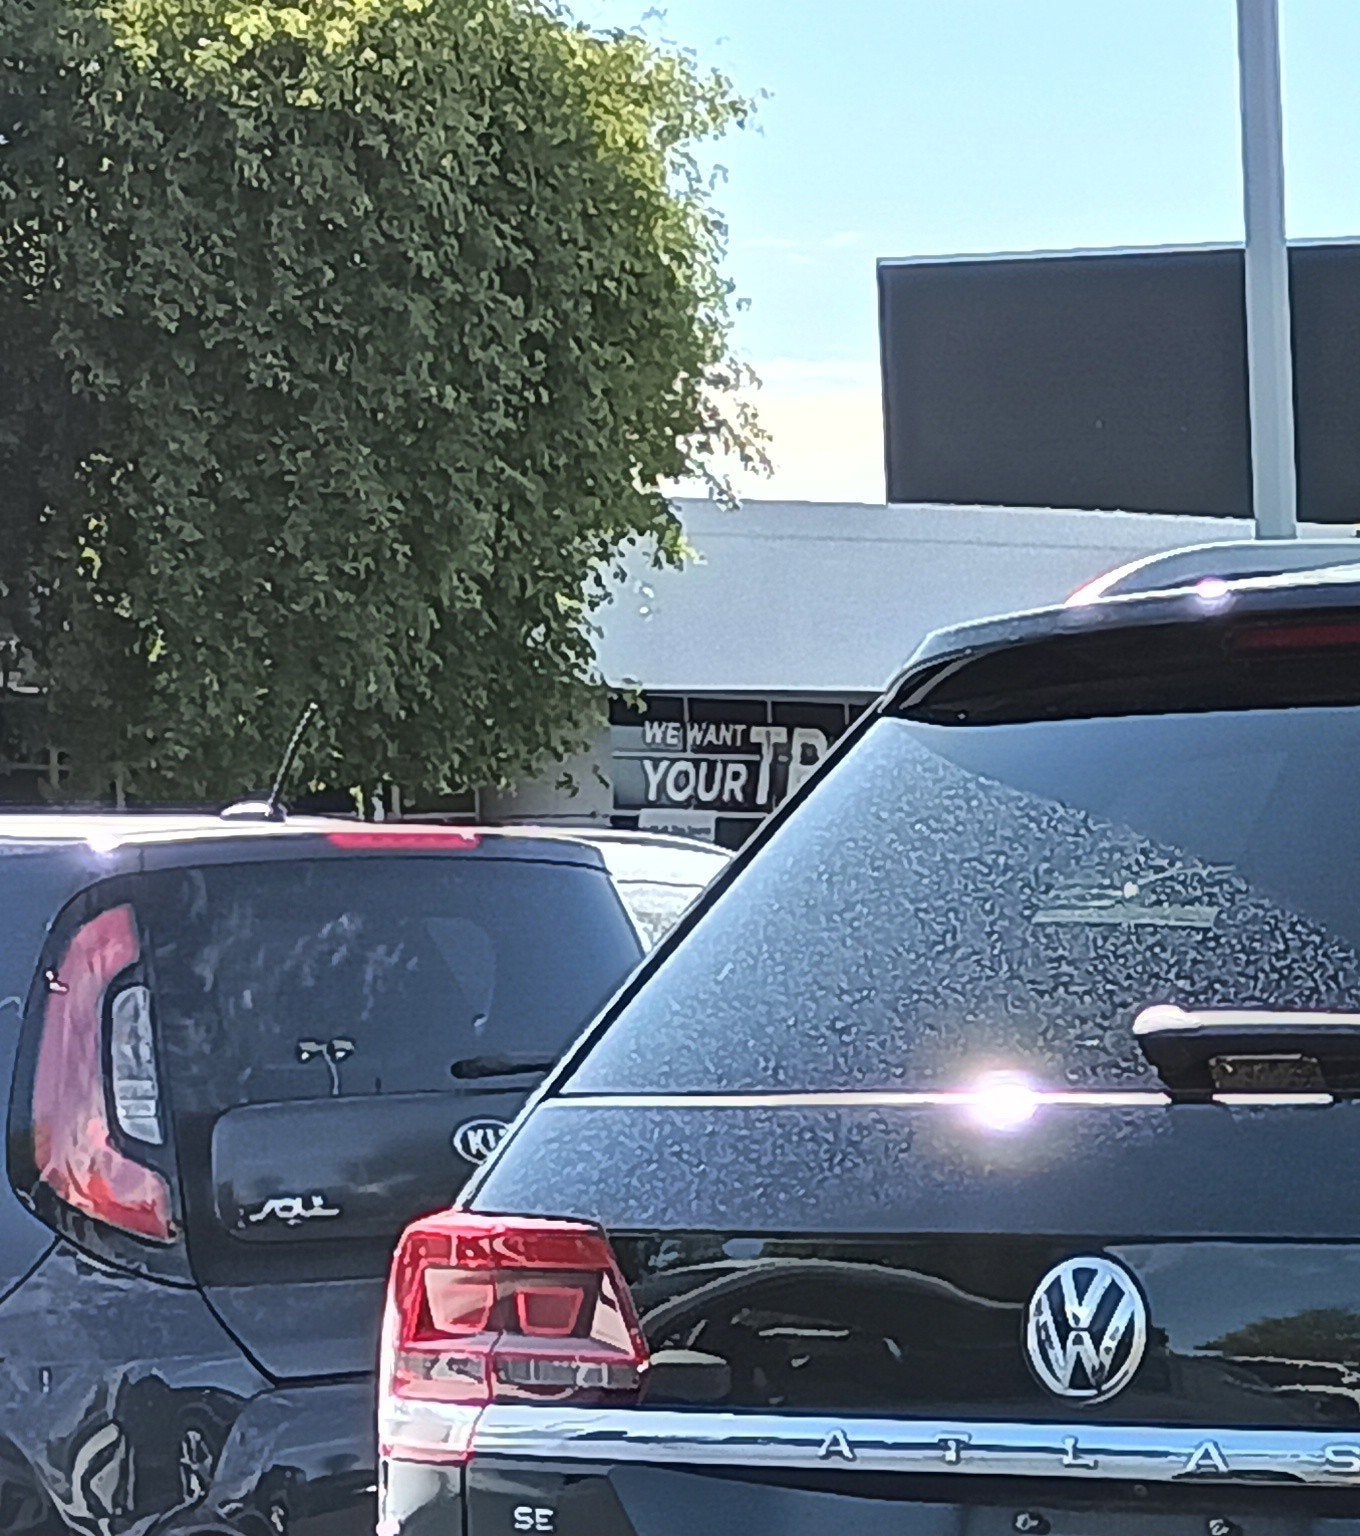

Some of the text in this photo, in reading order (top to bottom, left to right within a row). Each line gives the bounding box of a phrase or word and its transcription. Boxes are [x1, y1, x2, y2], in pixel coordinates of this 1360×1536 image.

[643, 721, 747, 747] WE WANT
[644, 759, 747, 803] YOUR
[513, 1505, 554, 1531] SE
